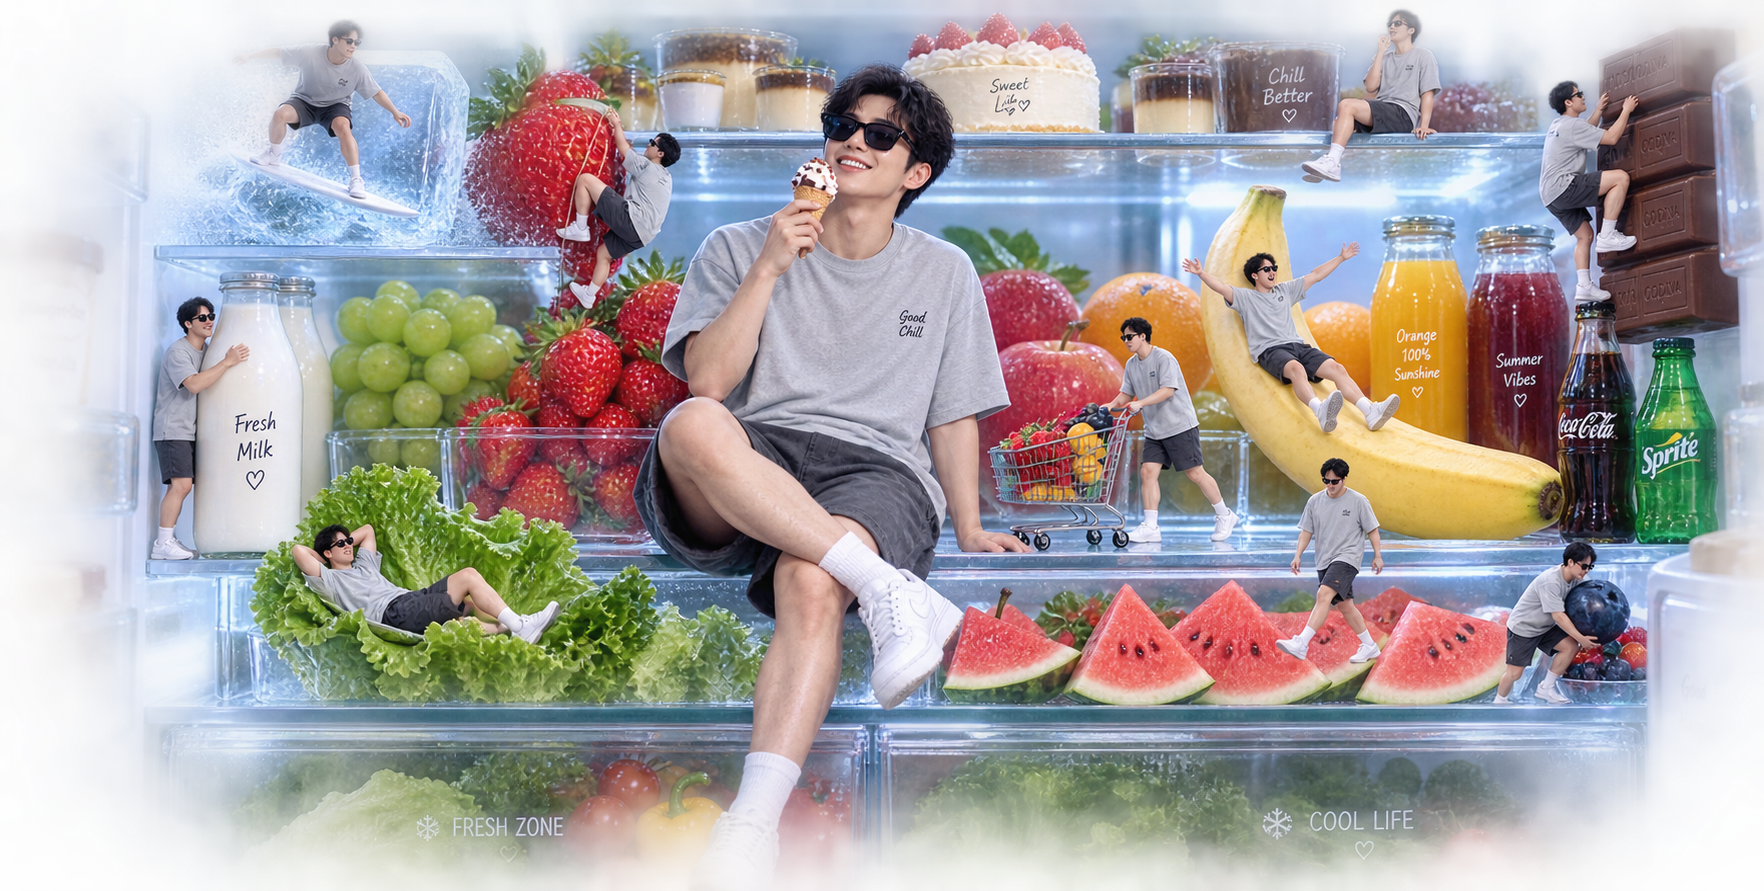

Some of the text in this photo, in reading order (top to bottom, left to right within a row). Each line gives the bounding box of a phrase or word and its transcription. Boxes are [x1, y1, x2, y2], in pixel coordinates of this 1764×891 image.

[1269, 66, 1306, 84] Chill
[990, 77, 1029, 94] Sweet
[1262, 87, 1313, 105] Better
[899, 309, 928, 325] Good
[899, 325, 924, 338] Chill
[1396, 328, 1437, 346] Orange
[1402, 347, 1431, 362] 100%
[1495, 352, 1543, 369] Summer
[1394, 365, 1440, 381] Sunshine
[1503, 371, 1537, 388] Vibes
[235, 411, 276, 434] Fresh
[237, 439, 273, 461] Milk
[1641, 432, 1699, 480] Sprite
[453, 816, 564, 837] FRESH ZONE
[1310, 809, 1414, 832] COOL LIFE
